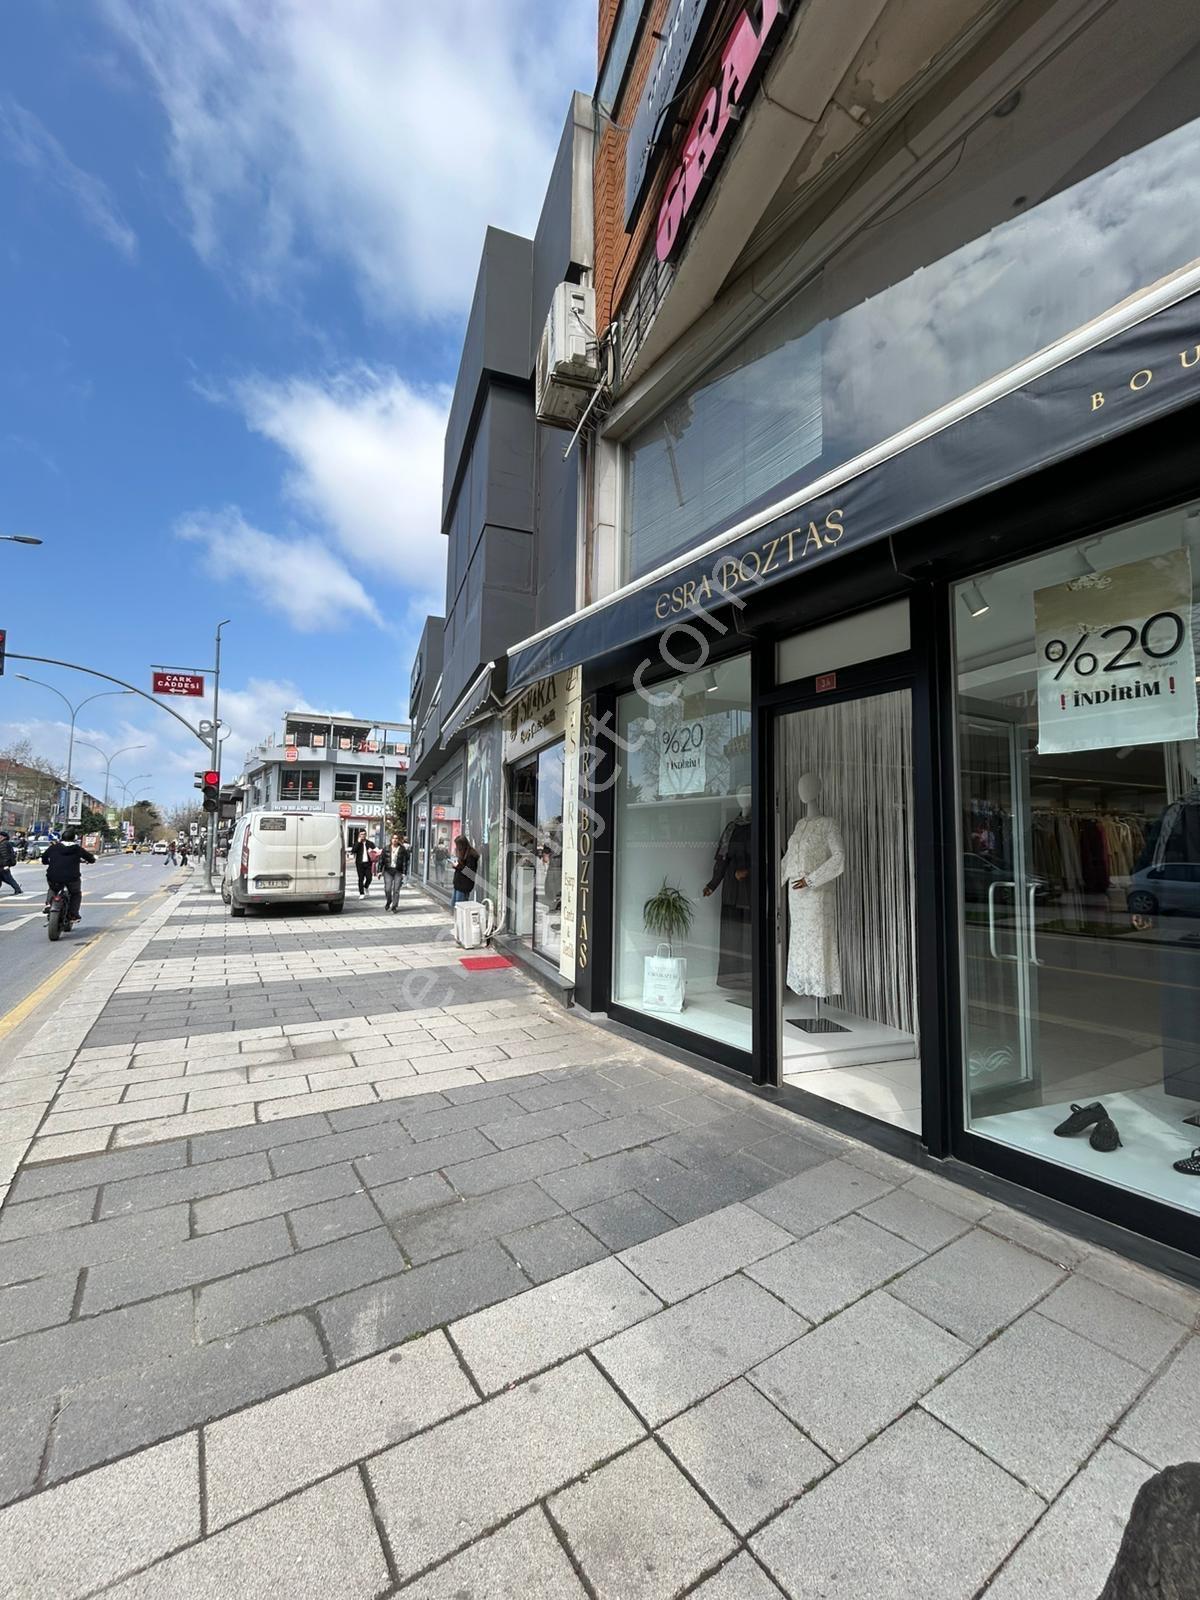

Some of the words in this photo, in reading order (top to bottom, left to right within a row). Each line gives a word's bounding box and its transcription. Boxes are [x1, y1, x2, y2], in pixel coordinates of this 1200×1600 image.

[655, 574, 713, 619] ESRA
[722, 508, 844, 592] BOZTAŞ
[1044, 611, 1184, 681] %20
[1073, 680, 1161, 708] İNDİRİM
[662, 723, 704, 755] %20
